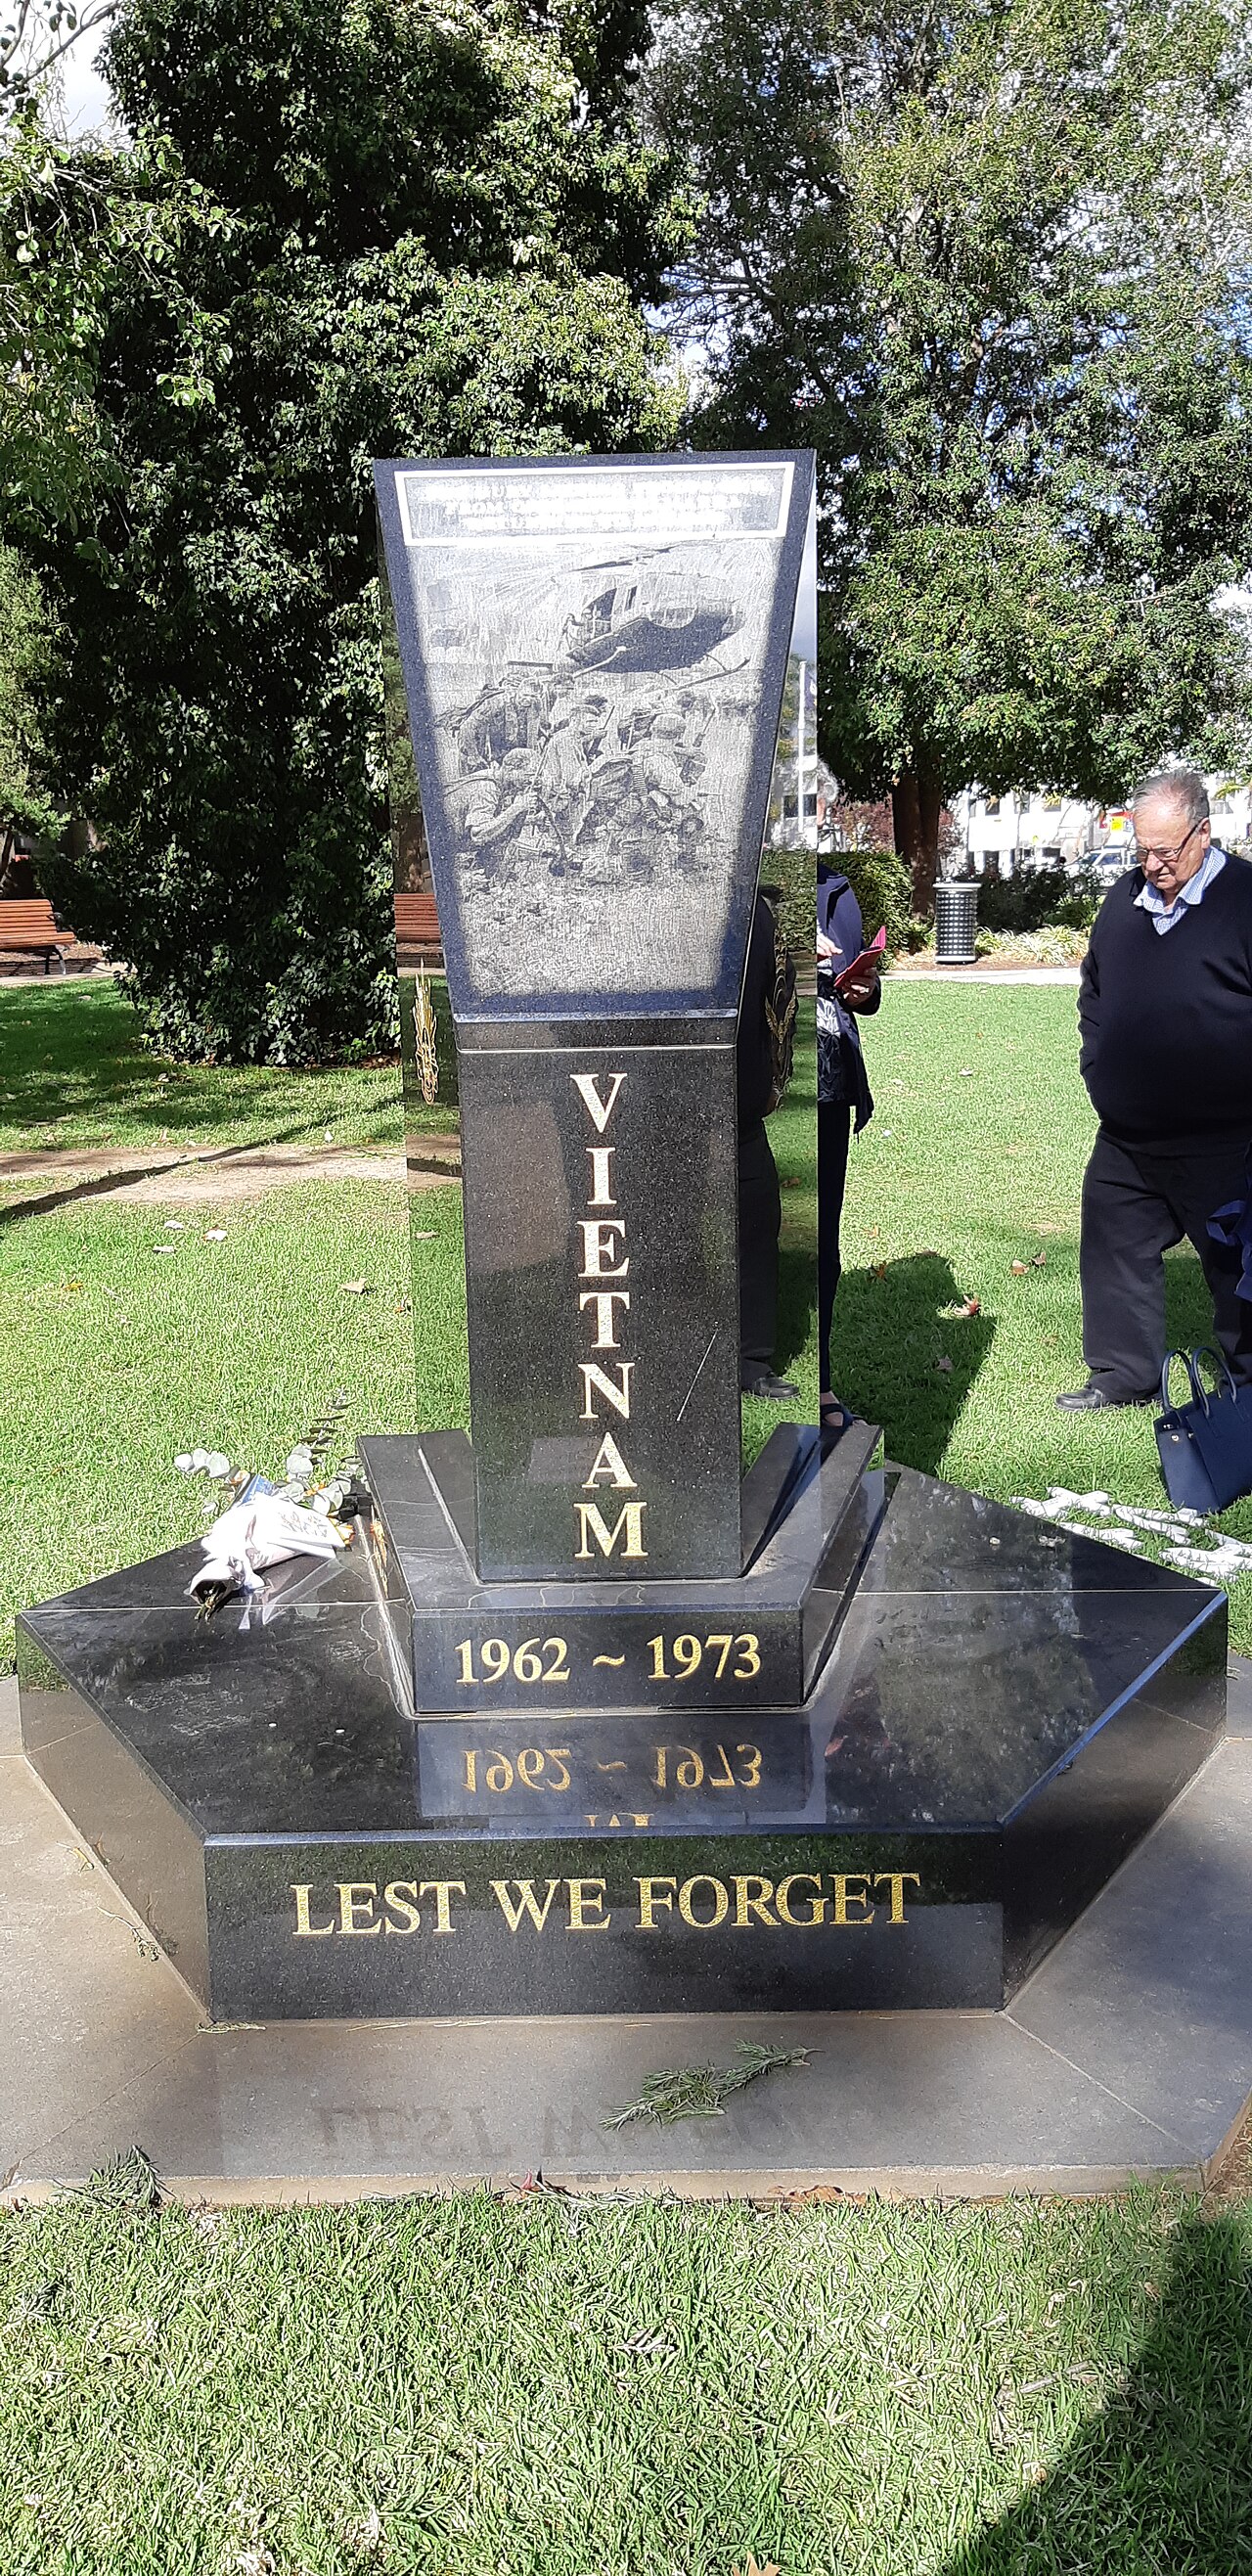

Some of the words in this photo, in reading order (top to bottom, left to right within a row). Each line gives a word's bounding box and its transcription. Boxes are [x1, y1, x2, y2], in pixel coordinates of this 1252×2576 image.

[569, 1072, 648, 1559] VIETNAM
[454, 1637, 571, 1684] 1962
[646, 1633, 762, 1680] 1973
[290, 1880, 467, 1937] LEST
[489, 1876, 611, 1933] WE
[632, 1871, 921, 1929] FORGET
